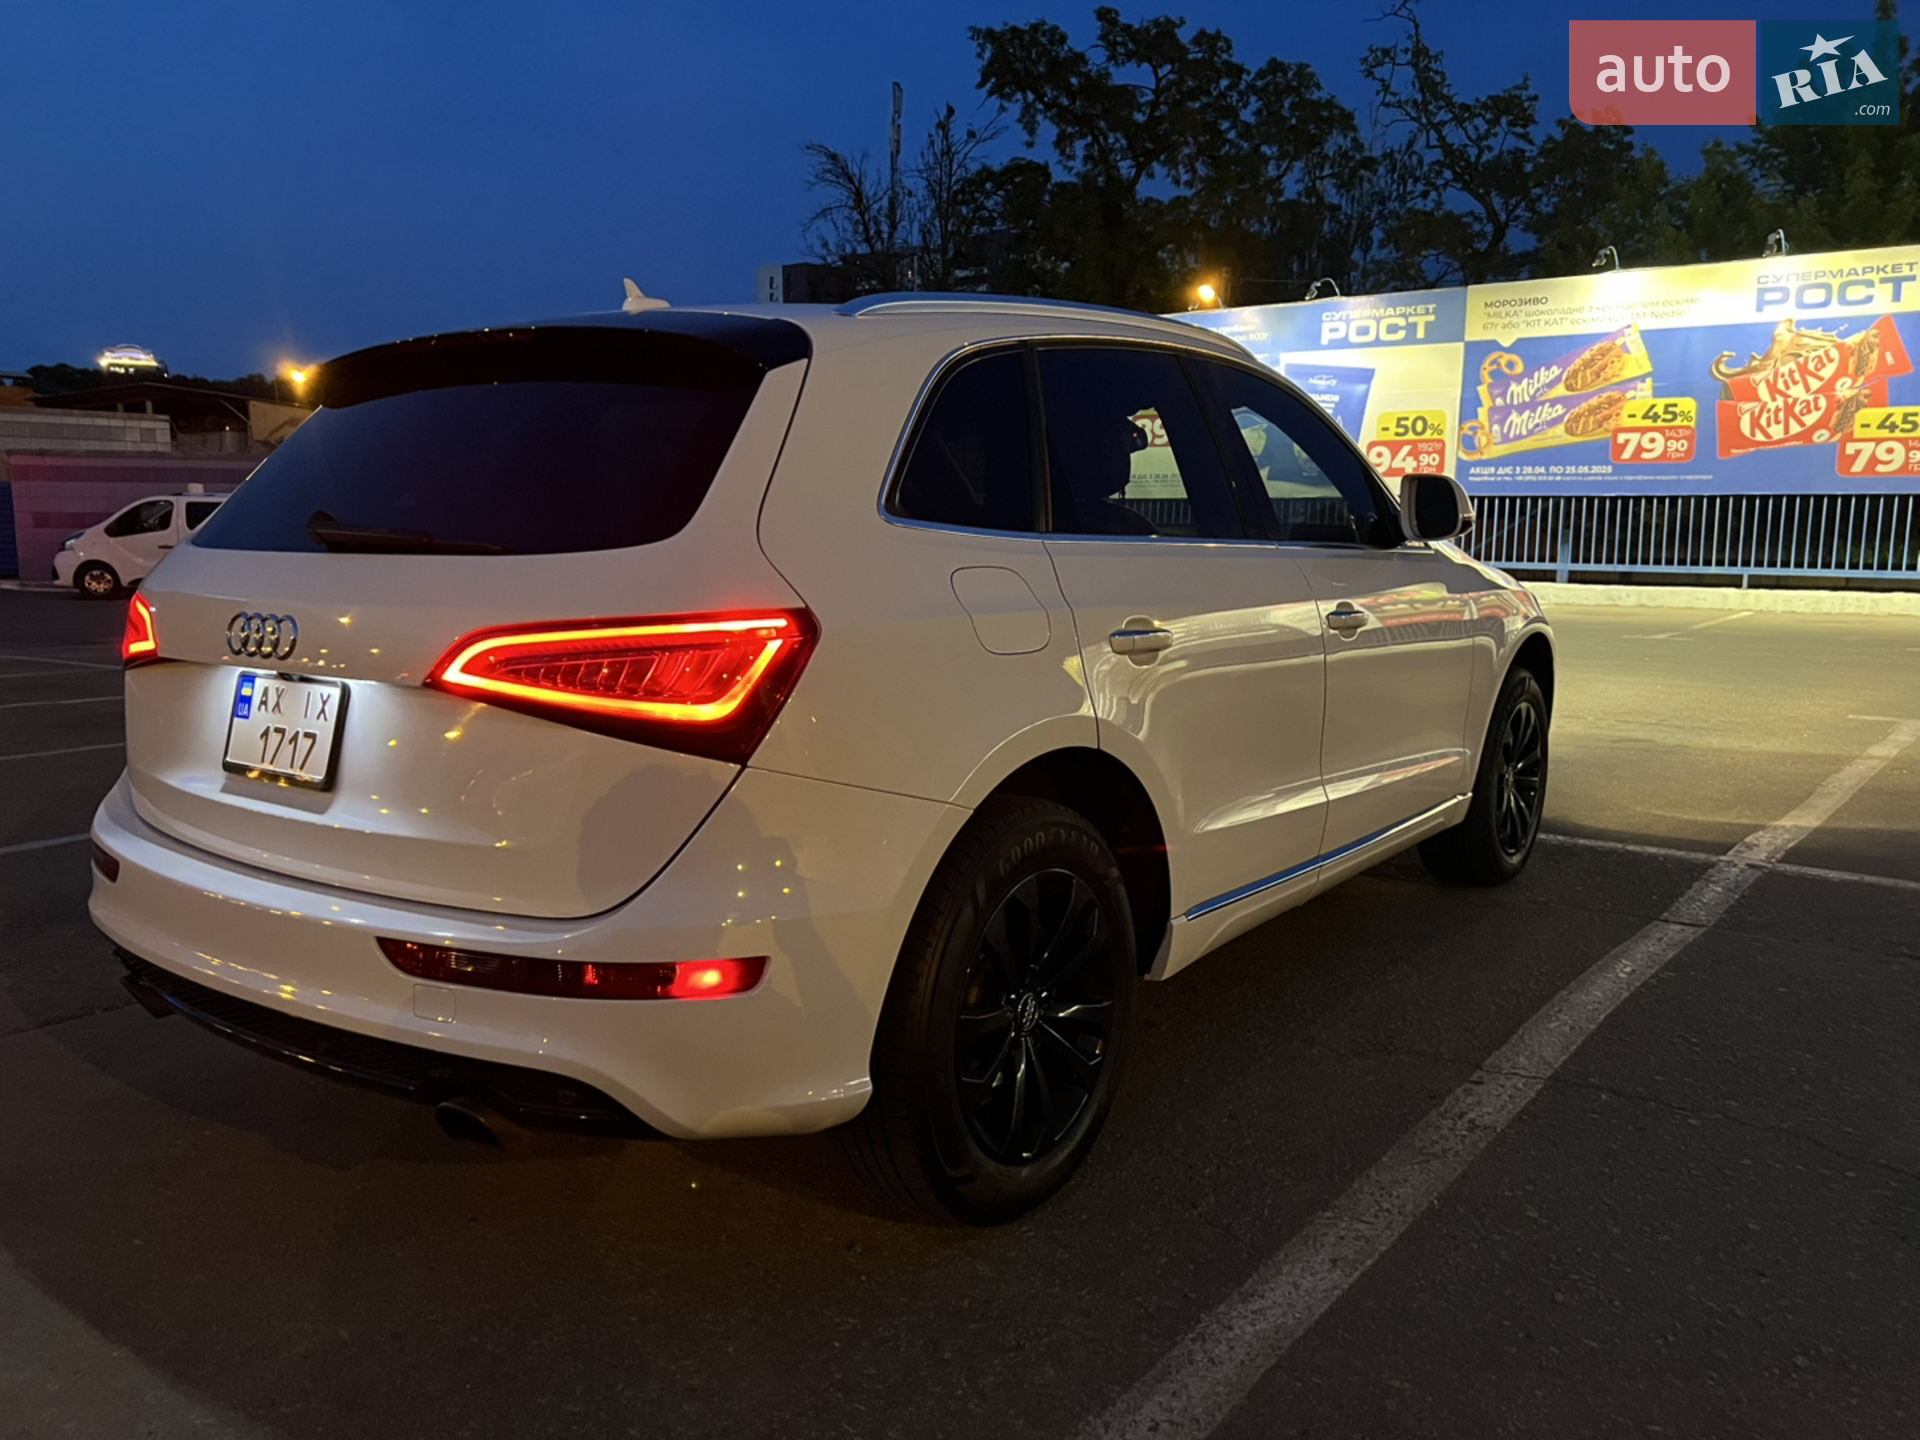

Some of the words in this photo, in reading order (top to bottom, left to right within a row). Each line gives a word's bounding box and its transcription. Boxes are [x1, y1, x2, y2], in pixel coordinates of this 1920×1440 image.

[1757, 262, 1919, 285] СУПЕРМАРКЕТ
[1484, 296, 1549, 309] МОРОЗИВО
[1756, 275, 1918, 313] РОСТ
[1321, 304, 1437, 321] СУПЕРМАРКЕТ
[1500, 320, 1520, 330] або
[1320, 315, 1436, 345] РОСТ
[1506, 365, 1563, 405] Milka
[1503, 402, 1567, 438] Milka
[1641, 402, 1694, 424] 45%
[1749, 393, 1822, 440] KitKat
[1394, 415, 1443, 437] 50%
[1616, 431, 1666, 459] 79
[1666, 439, 1689, 452] 90
[1845, 440, 1906, 473] 79
[1368, 445, 1418, 474] 94
[1418, 453, 1441, 467] 90
[1549, 465, 1564, 473] ПО
[1565, 464, 1613, 473] 25.05.2025
[237, 702, 249, 717] UA
[257, 685, 287, 715] AX
[304, 690, 332, 722] IX
[259, 725, 319, 771] 1717
